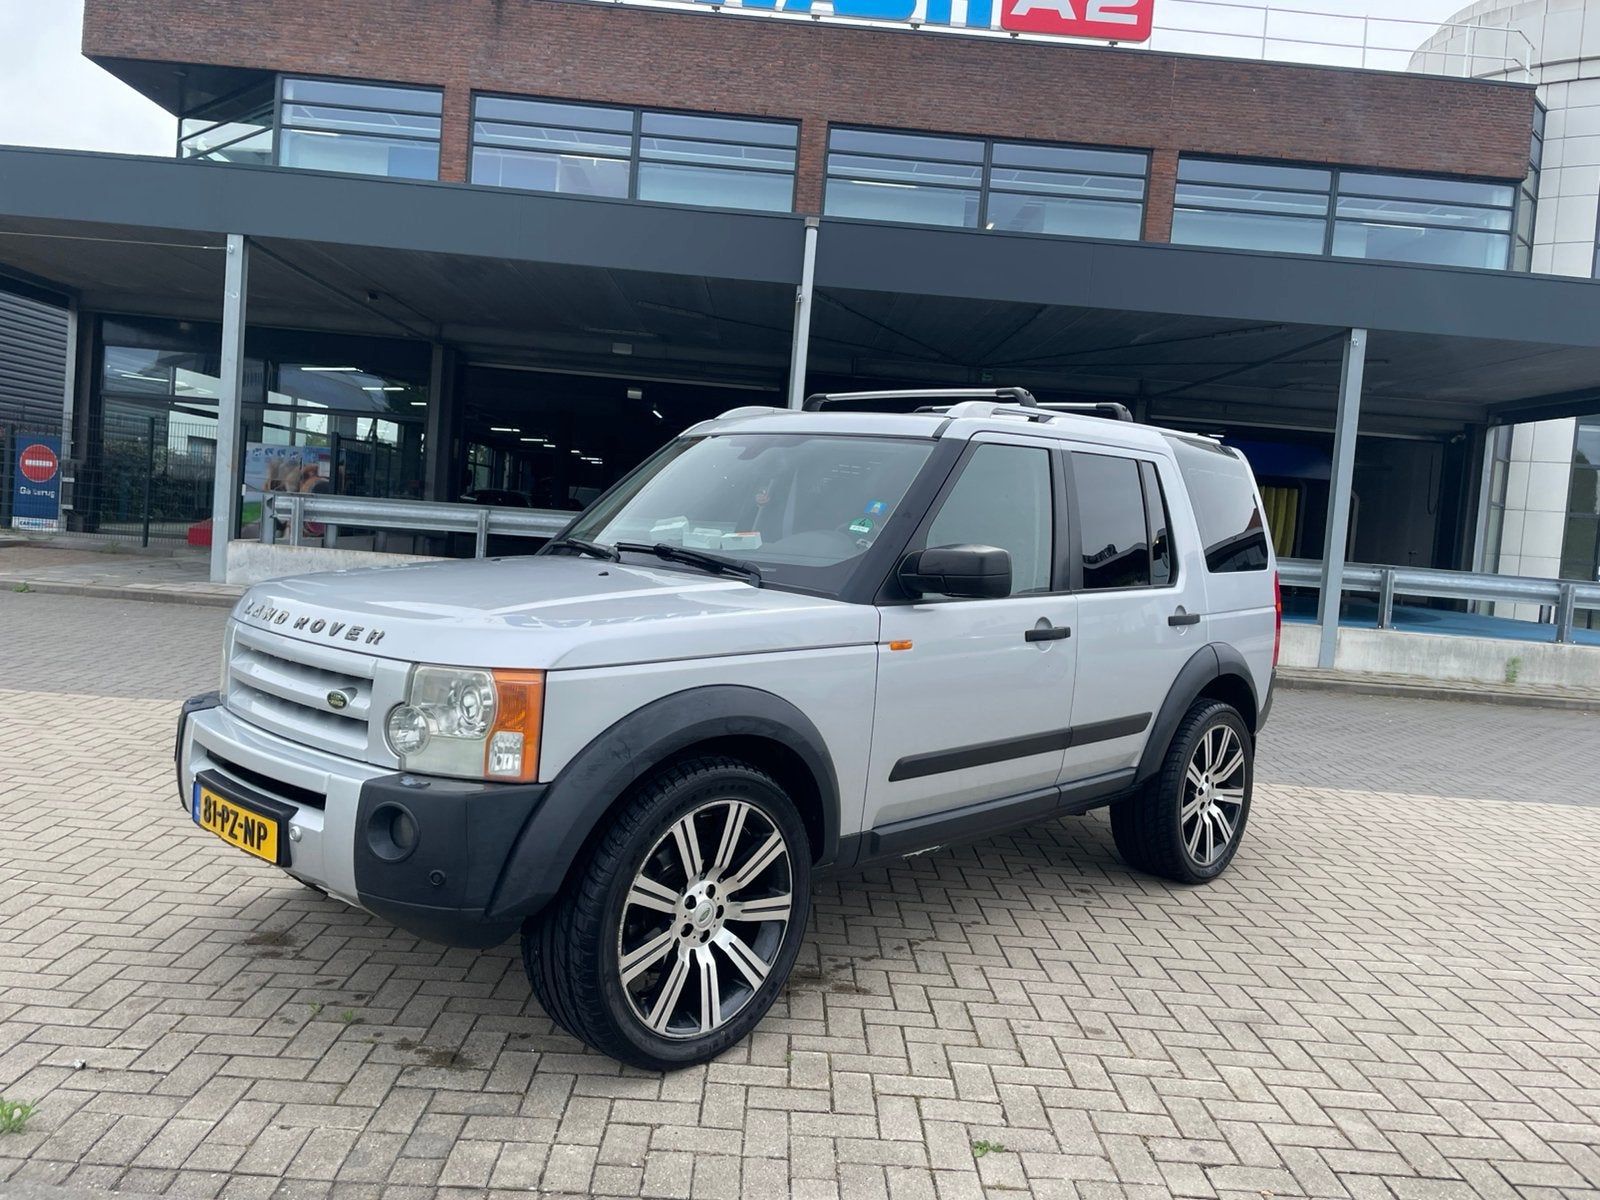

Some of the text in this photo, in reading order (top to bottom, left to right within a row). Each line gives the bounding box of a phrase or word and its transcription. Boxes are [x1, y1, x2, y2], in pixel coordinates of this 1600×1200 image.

[244, 601, 385, 645] LAND ROVER
[203, 795, 268, 851] 81-PZ-NP
